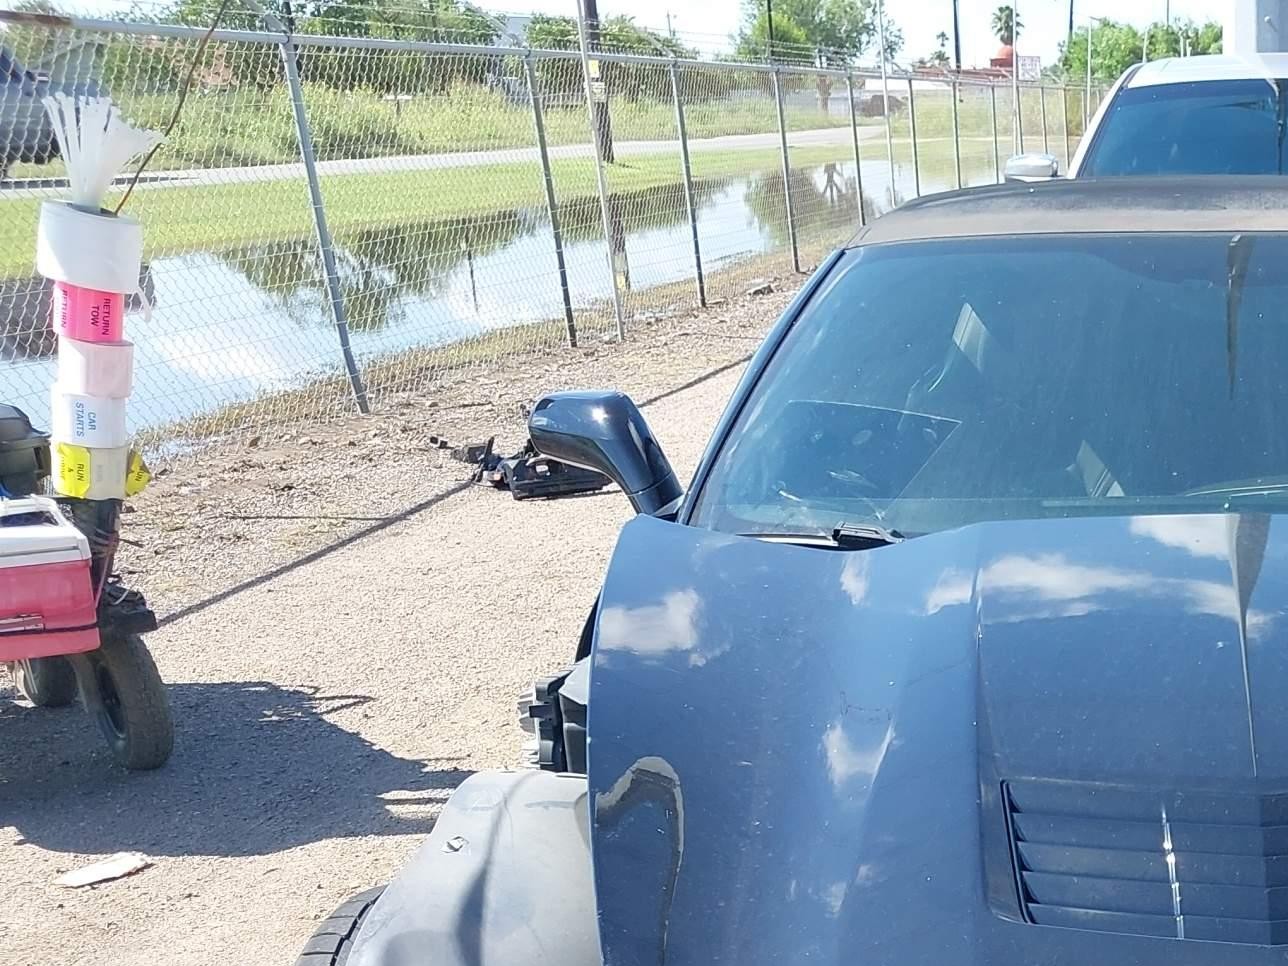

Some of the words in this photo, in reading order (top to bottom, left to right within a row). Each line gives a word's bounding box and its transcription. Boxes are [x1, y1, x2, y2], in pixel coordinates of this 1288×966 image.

[90, 305, 100, 327] TOW
[101, 298, 112, 335] RETURN
[75, 401, 85, 438] STARTS
[87, 411, 97, 430] CAR
[76, 463, 85, 482] RUN
